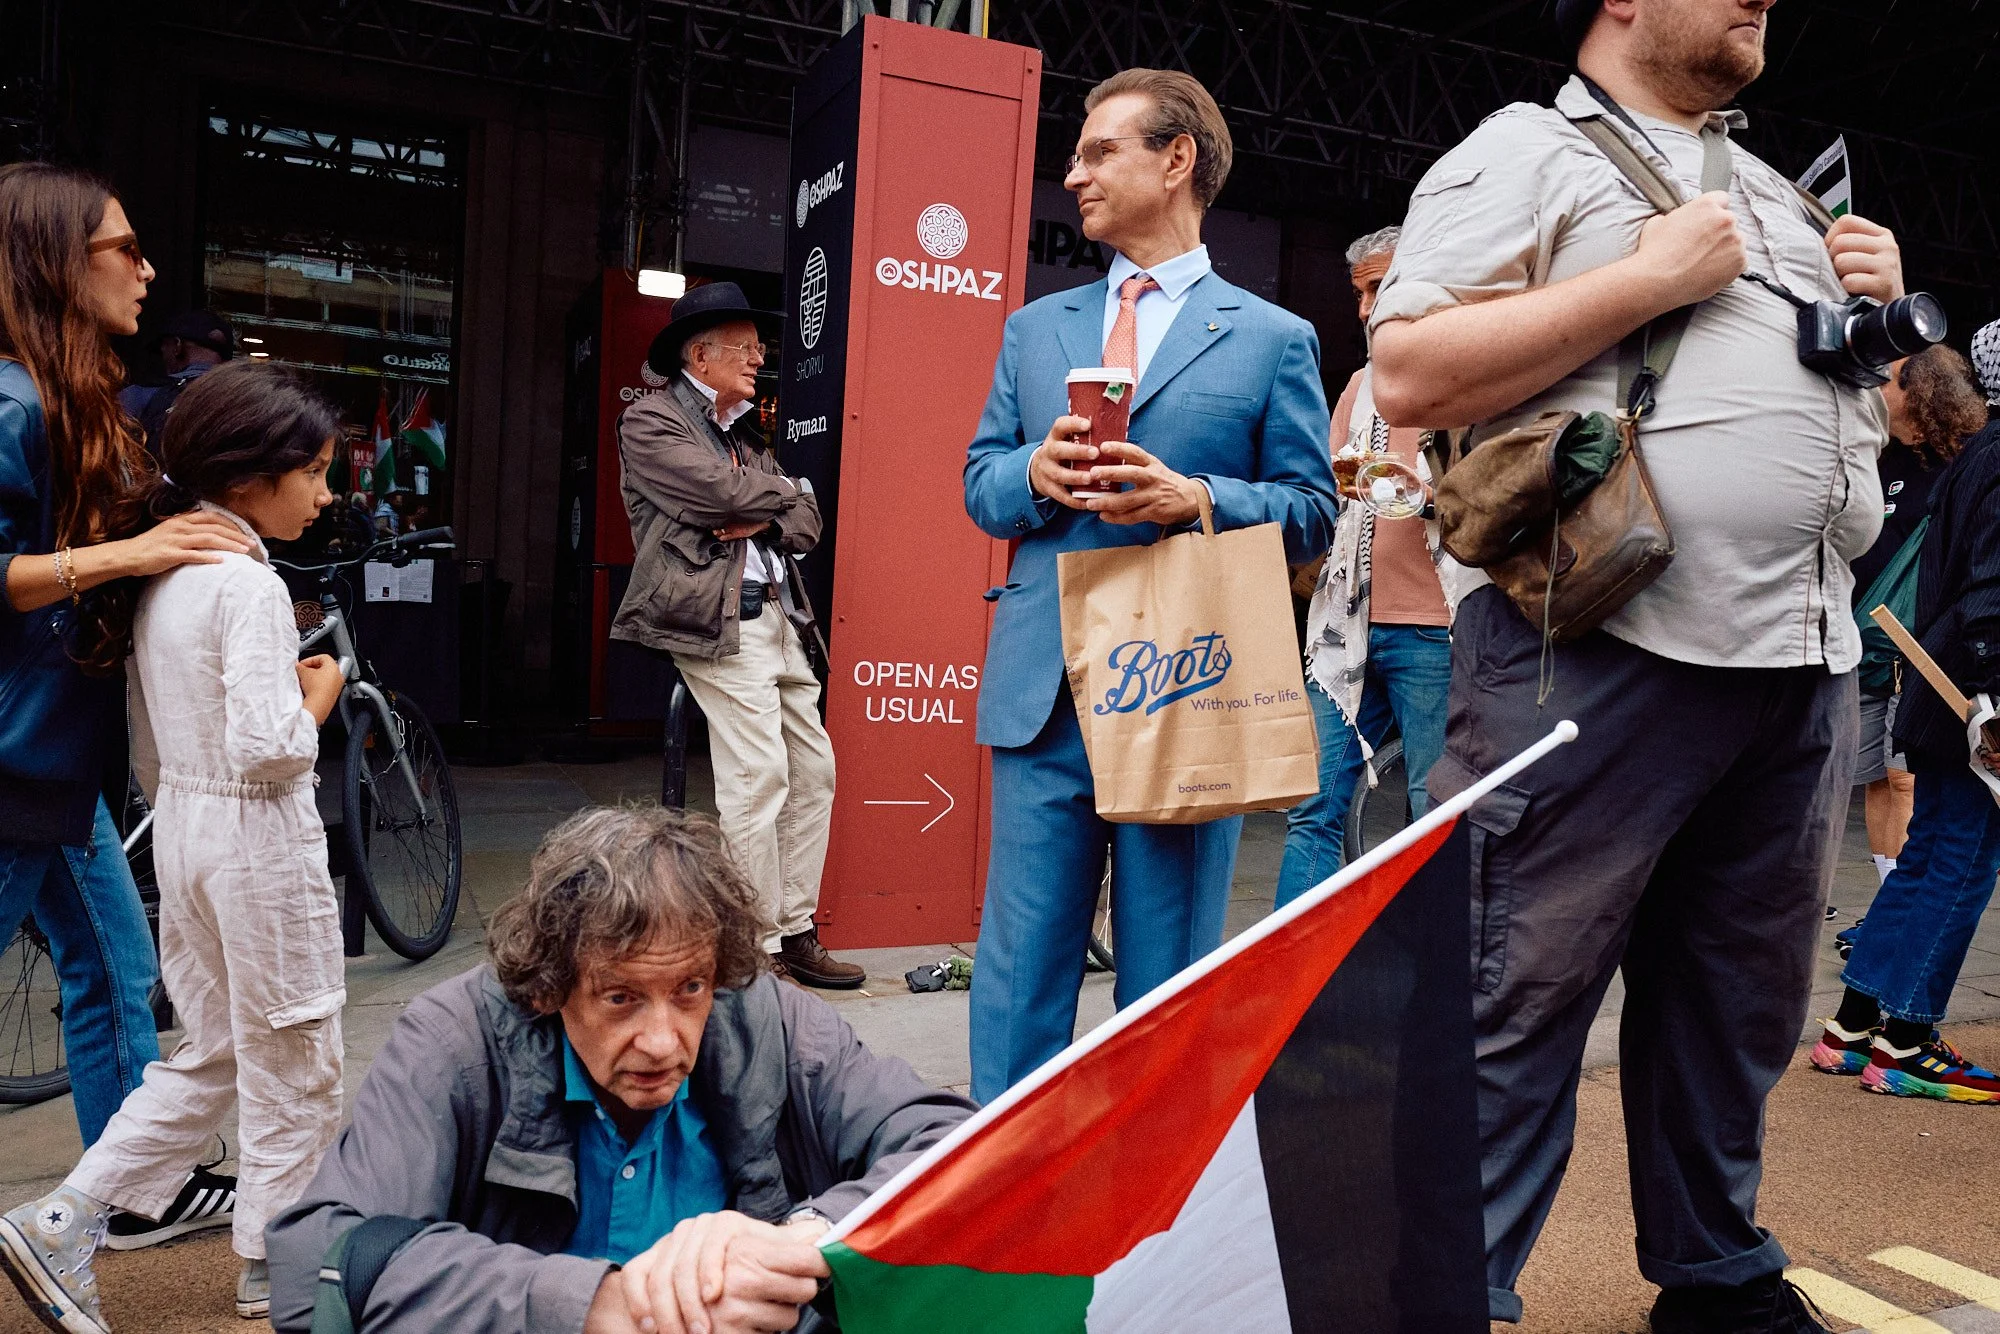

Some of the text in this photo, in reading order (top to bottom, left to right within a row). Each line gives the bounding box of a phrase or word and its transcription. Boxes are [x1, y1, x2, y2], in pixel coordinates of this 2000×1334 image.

[809, 161, 844, 208] OSHPAZ
[875, 257, 1003, 301] OSHPAZ
[796, 354, 824, 382] SHORYU
[786, 415, 827, 443] Ryman
[853, 660, 979, 690] OPEN AS
[1094, 631, 1233, 716] Boots
[865, 696, 964, 724] USUAL
[1191, 688, 1302, 713] With you. For life.
[1178, 781, 1232, 794] boots.com
